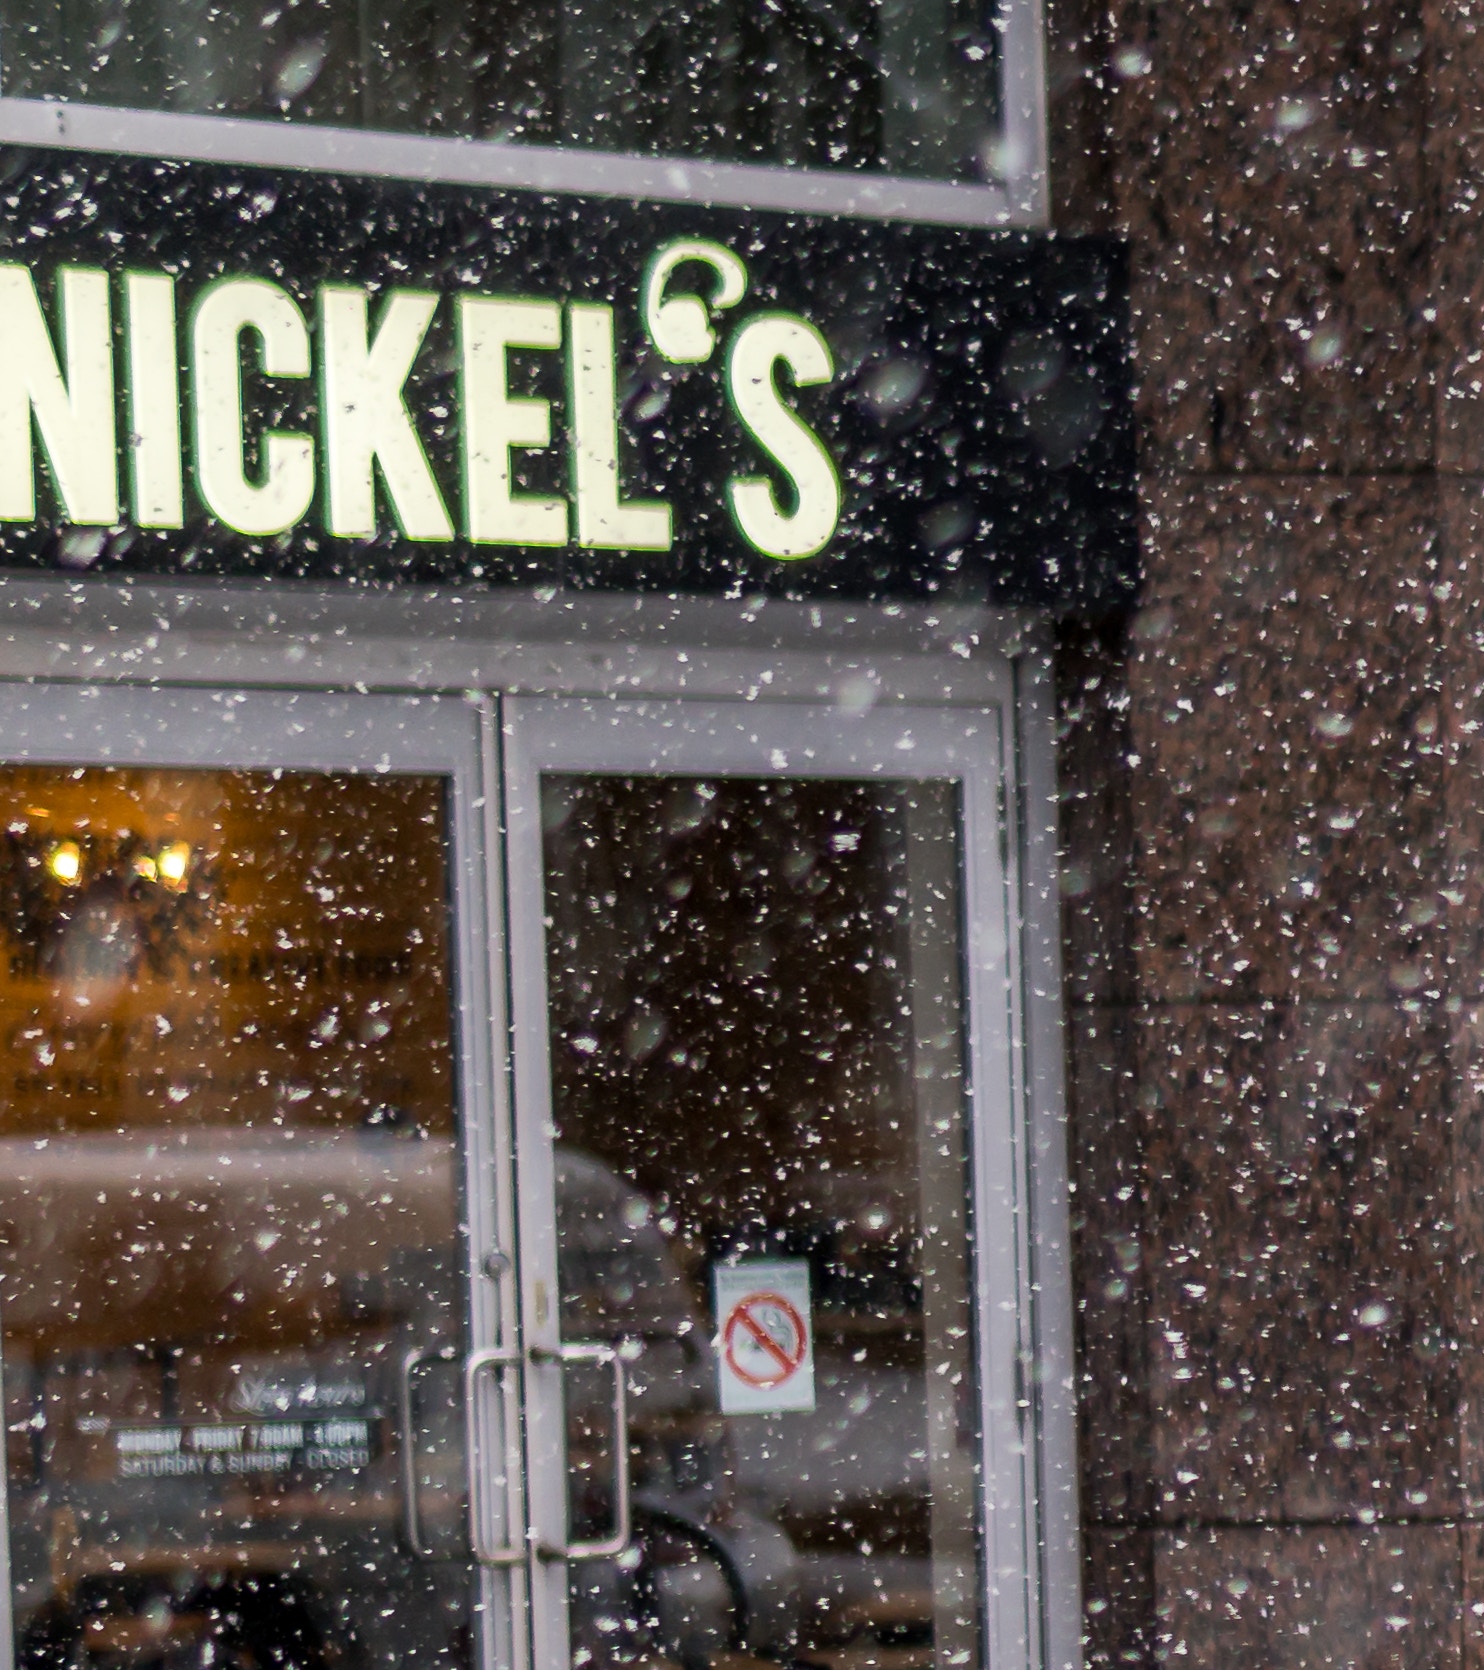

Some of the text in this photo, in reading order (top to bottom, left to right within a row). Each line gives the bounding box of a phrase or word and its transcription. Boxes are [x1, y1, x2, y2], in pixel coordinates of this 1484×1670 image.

[0, 236, 843, 561] NICKEL'S
[193, 1425, 243, 1451] FRIDAY
[120, 1453, 204, 1476] SATURDAY
[209, 1454, 224, 1474] &
[229, 1451, 293, 1473] SUNDAY
[307, 1448, 369, 1468] CLOSED
